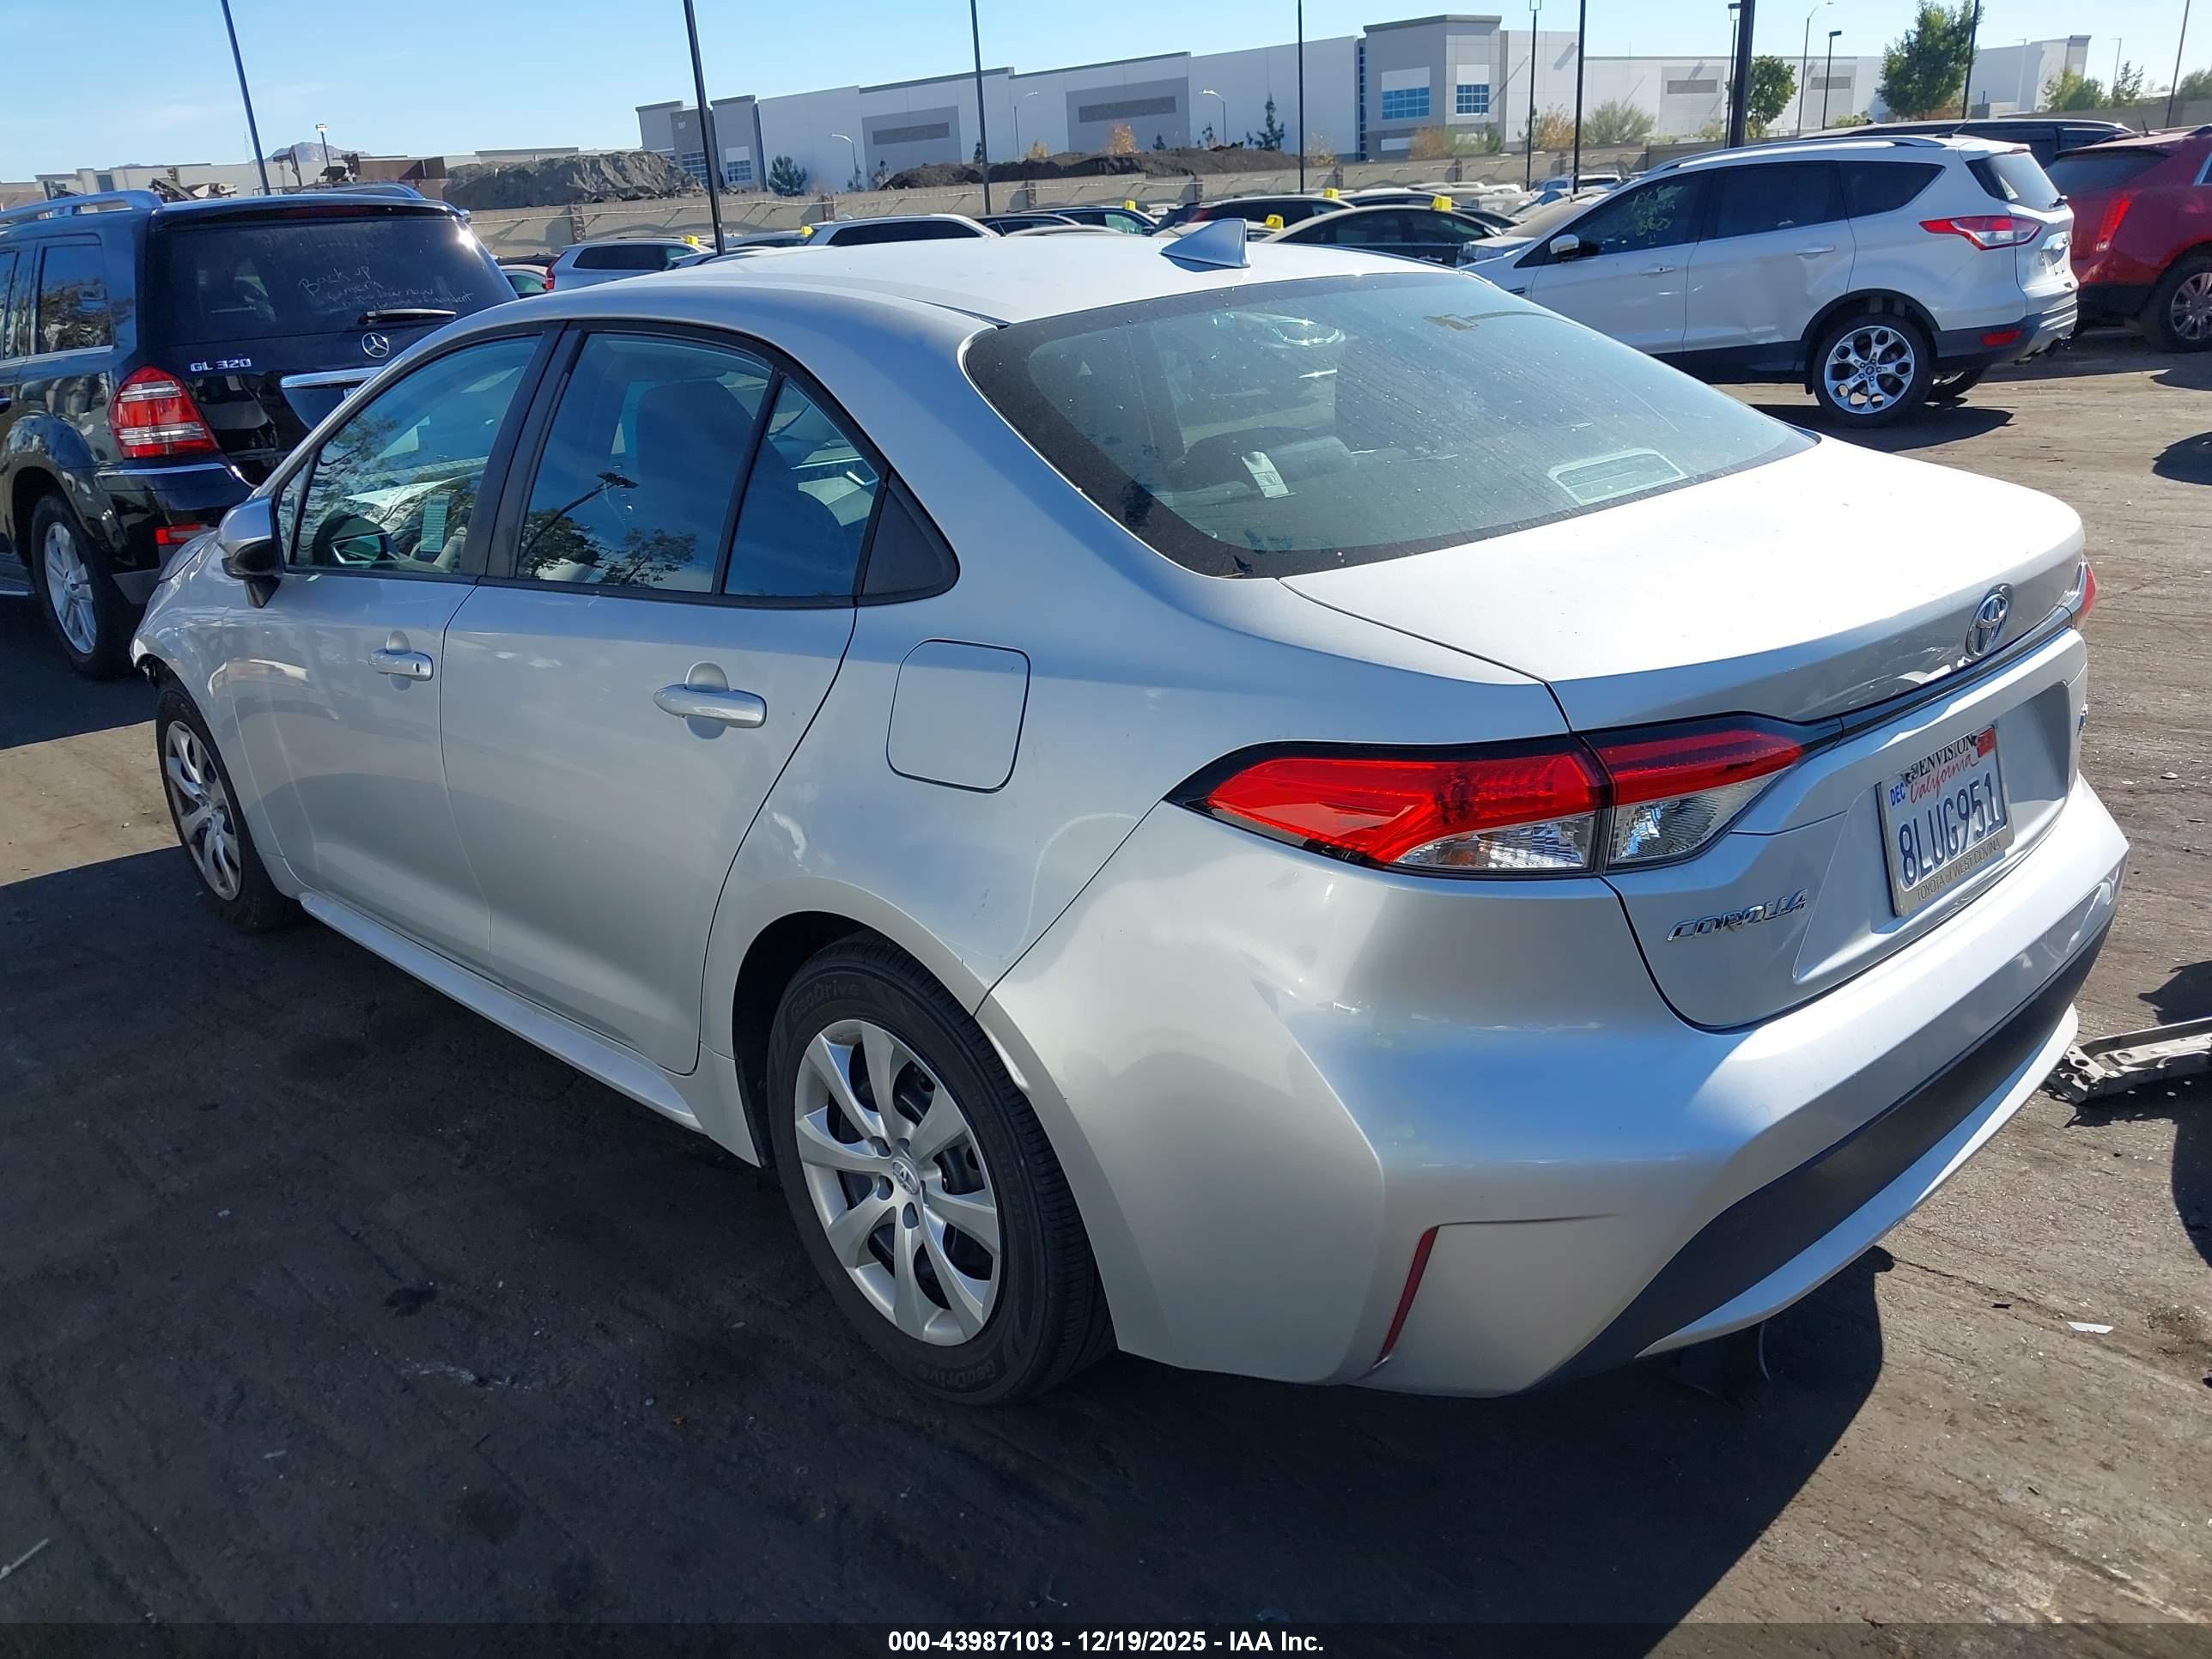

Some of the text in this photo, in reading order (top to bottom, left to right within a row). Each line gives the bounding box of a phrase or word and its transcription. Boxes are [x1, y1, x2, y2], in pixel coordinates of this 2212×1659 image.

[299, 268, 350, 296] Back
[190, 358, 252, 372] GL 320
[1918, 733, 1976, 777] ENVISION
[1890, 781, 1906, 806] DEC
[1909, 753, 1979, 804] California
[1898, 772, 2002, 886] 8LUG951
[1916, 876, 1945, 901] TOYOTA
[1952, 854, 1973, 875] WEST
[1667, 888, 1808, 942] COROLLA
